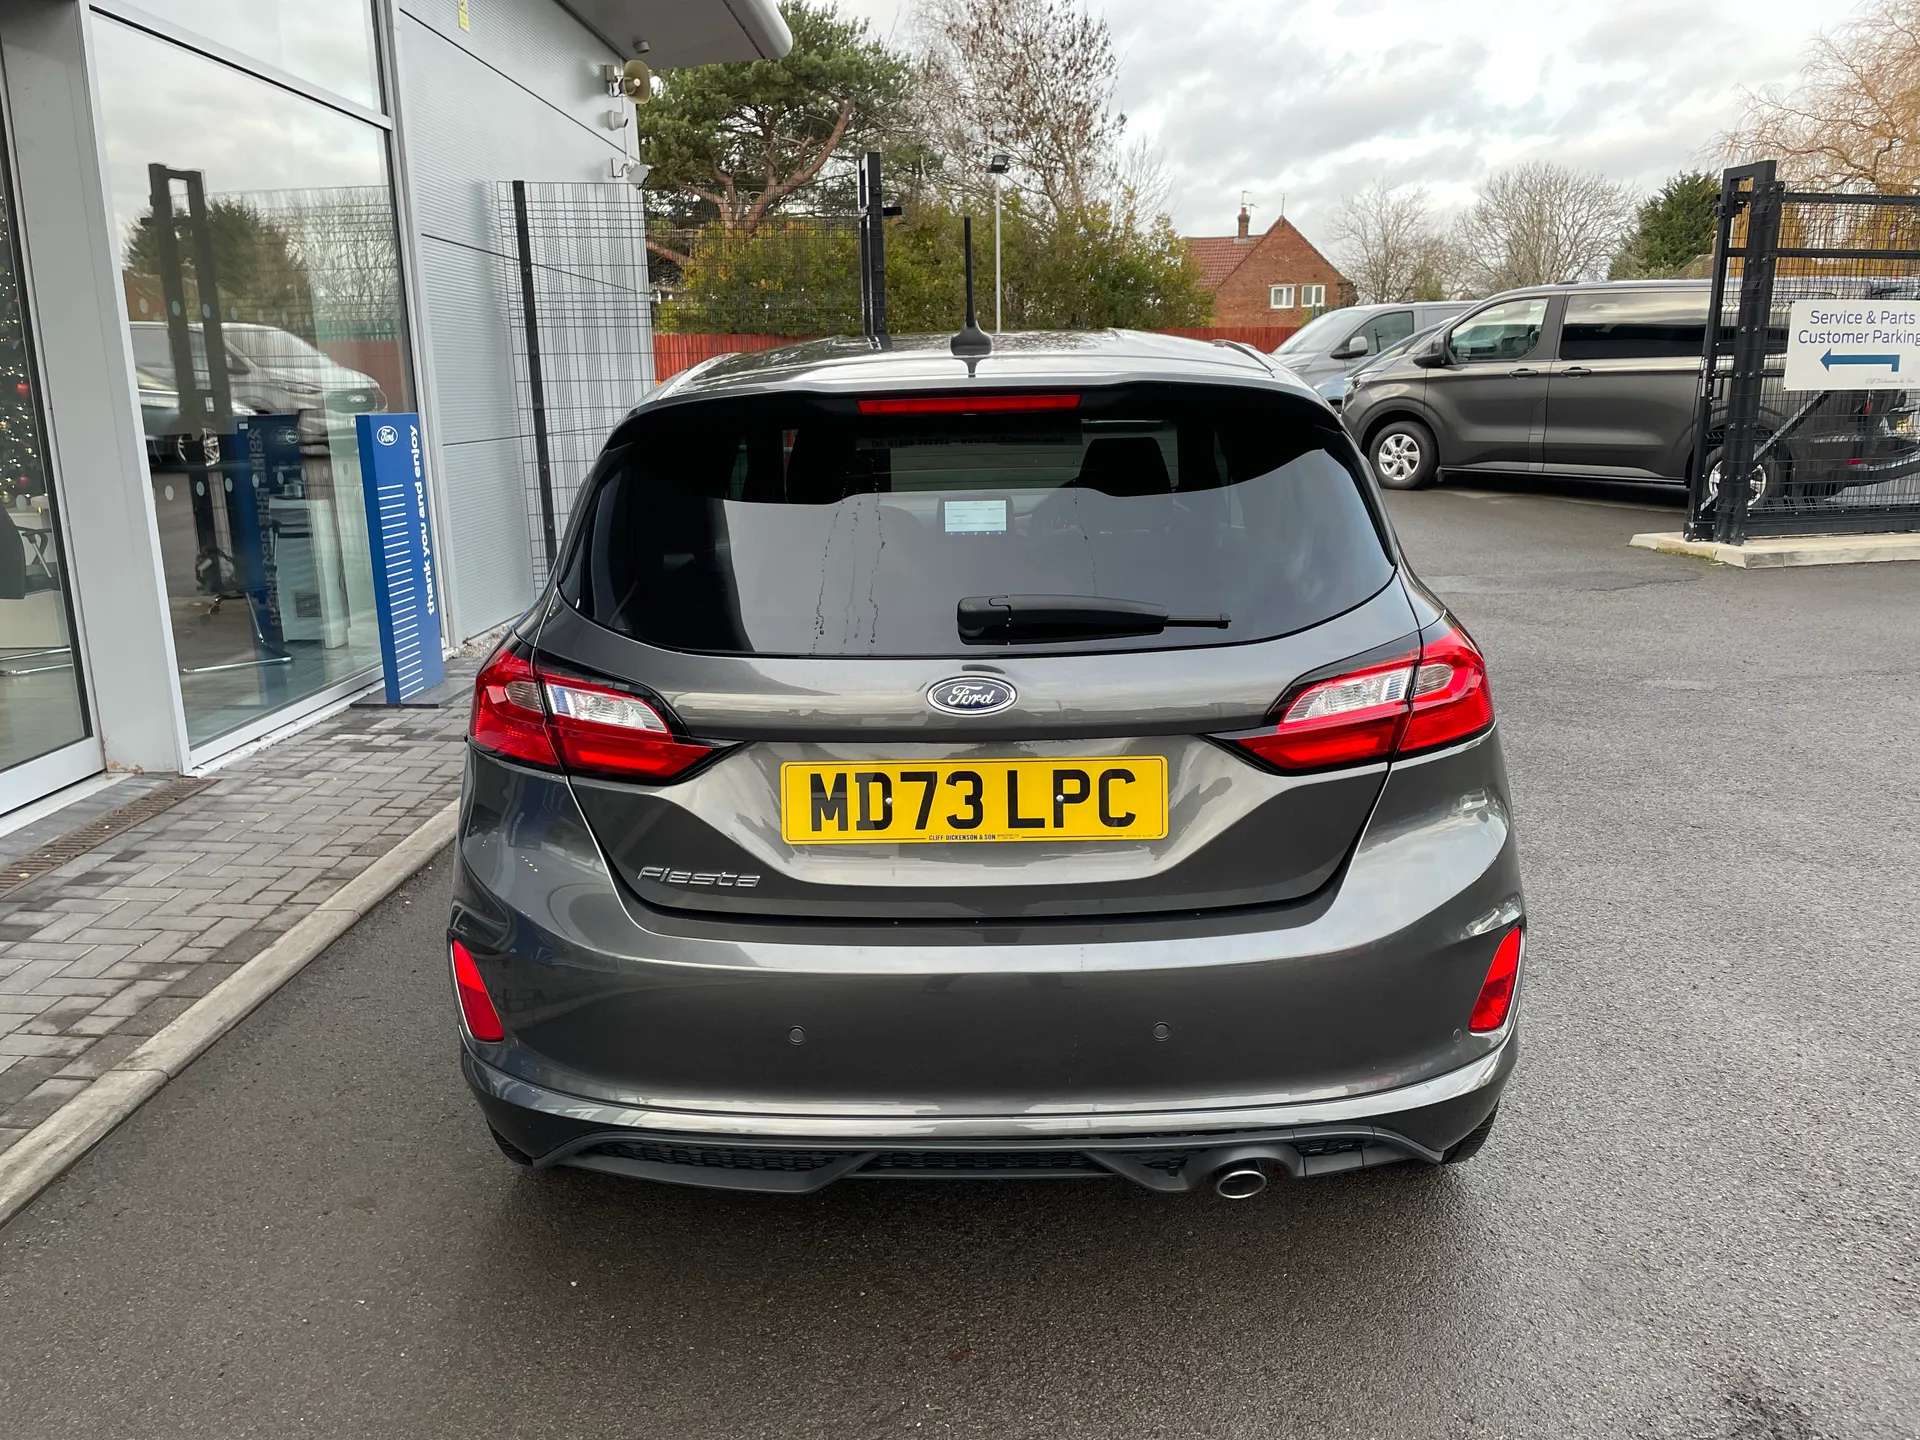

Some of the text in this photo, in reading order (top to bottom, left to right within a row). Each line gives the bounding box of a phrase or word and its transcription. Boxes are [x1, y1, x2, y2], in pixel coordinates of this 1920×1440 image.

[1809, 310, 1916, 325] Service & Parts
[1798, 328, 1920, 347] Customer Parking
[409, 424, 435, 617] thank you and enjoy
[947, 685, 995, 706] Ford
[810, 768, 1137, 833] MD73 LPC
[984, 833, 996, 841] SON
[637, 866, 761, 888] Fiesta
